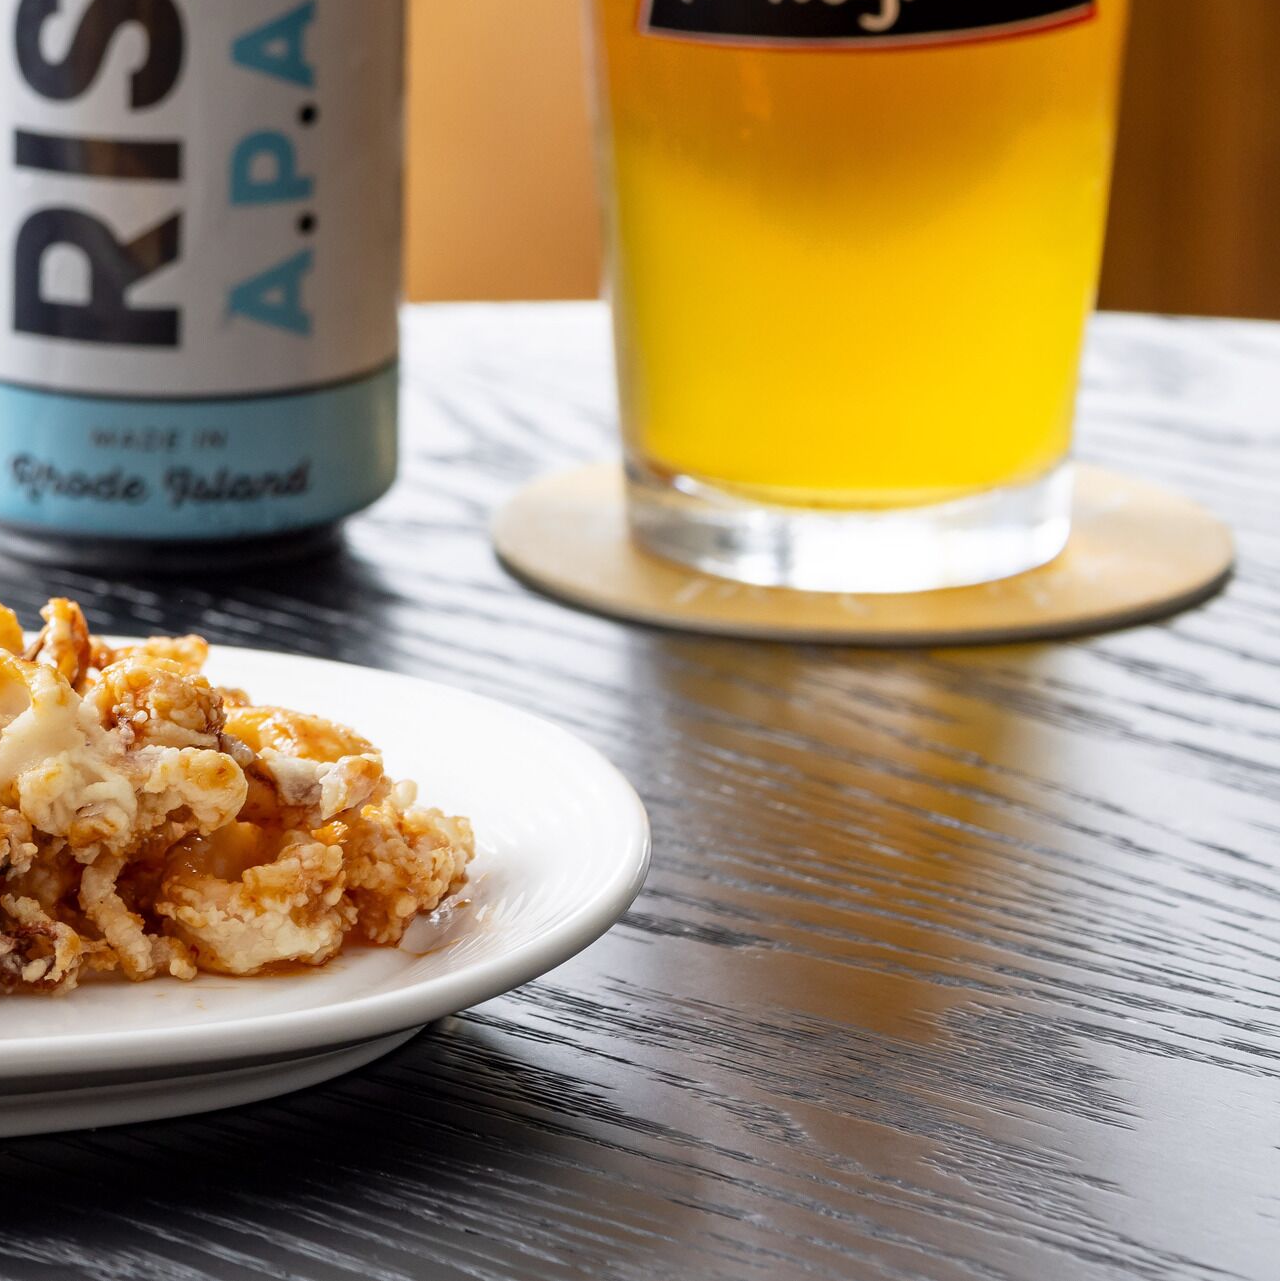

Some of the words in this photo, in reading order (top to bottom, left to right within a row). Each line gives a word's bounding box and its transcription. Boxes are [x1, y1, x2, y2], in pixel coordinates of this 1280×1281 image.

[93, 428, 178, 452] MADE
[194, 427, 228, 449] IN
[8, 451, 145, 501] Rhode
[165, 459, 312, 507] Island
